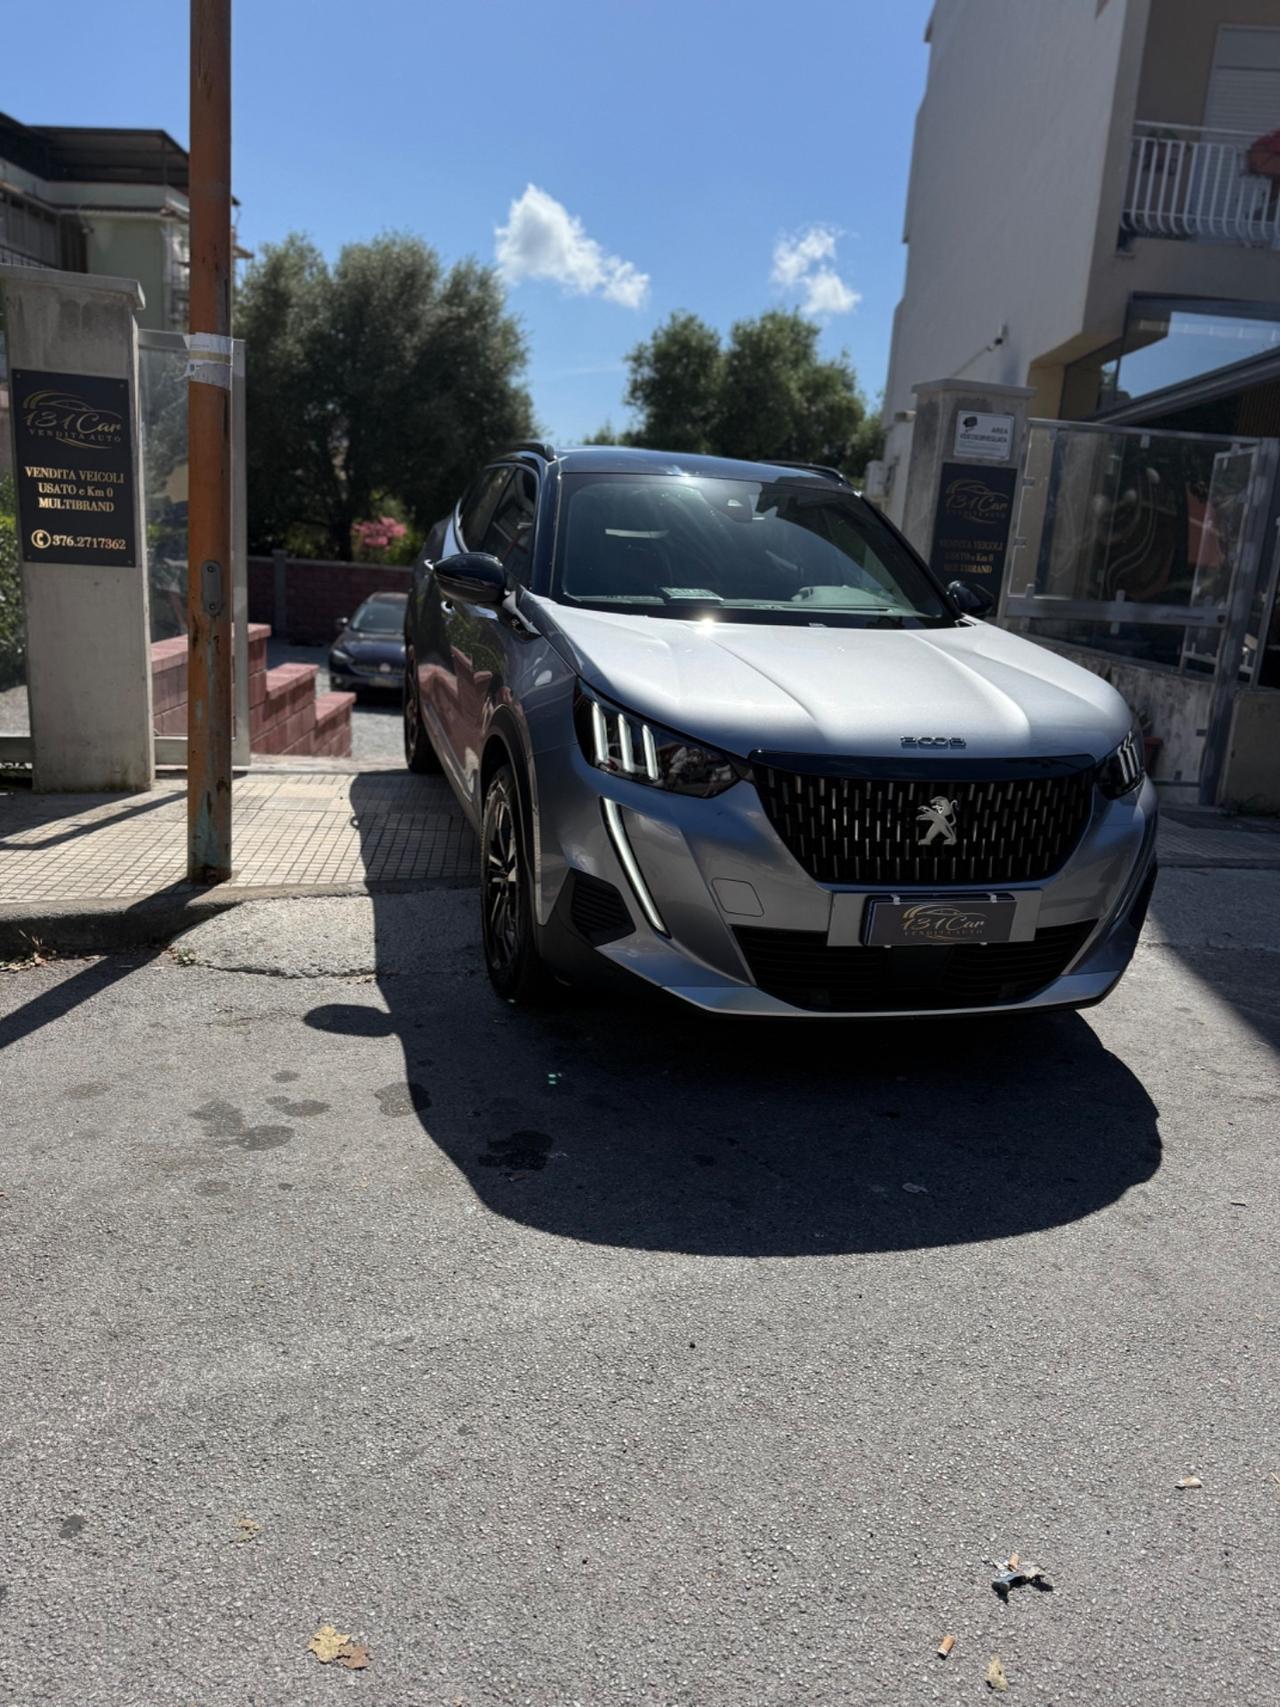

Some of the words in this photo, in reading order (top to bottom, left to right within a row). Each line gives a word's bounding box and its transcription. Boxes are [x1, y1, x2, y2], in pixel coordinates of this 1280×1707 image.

[90, 434, 122, 443] AUTO
[25, 466, 76, 481] VENDITA
[79, 469, 125, 484] VEICOLI
[37, 482, 76, 496] USATO
[87, 485, 105, 497] Km
[38, 497, 115, 512] MULTIBRAND
[52, 534, 126, 550] 376.2717362
